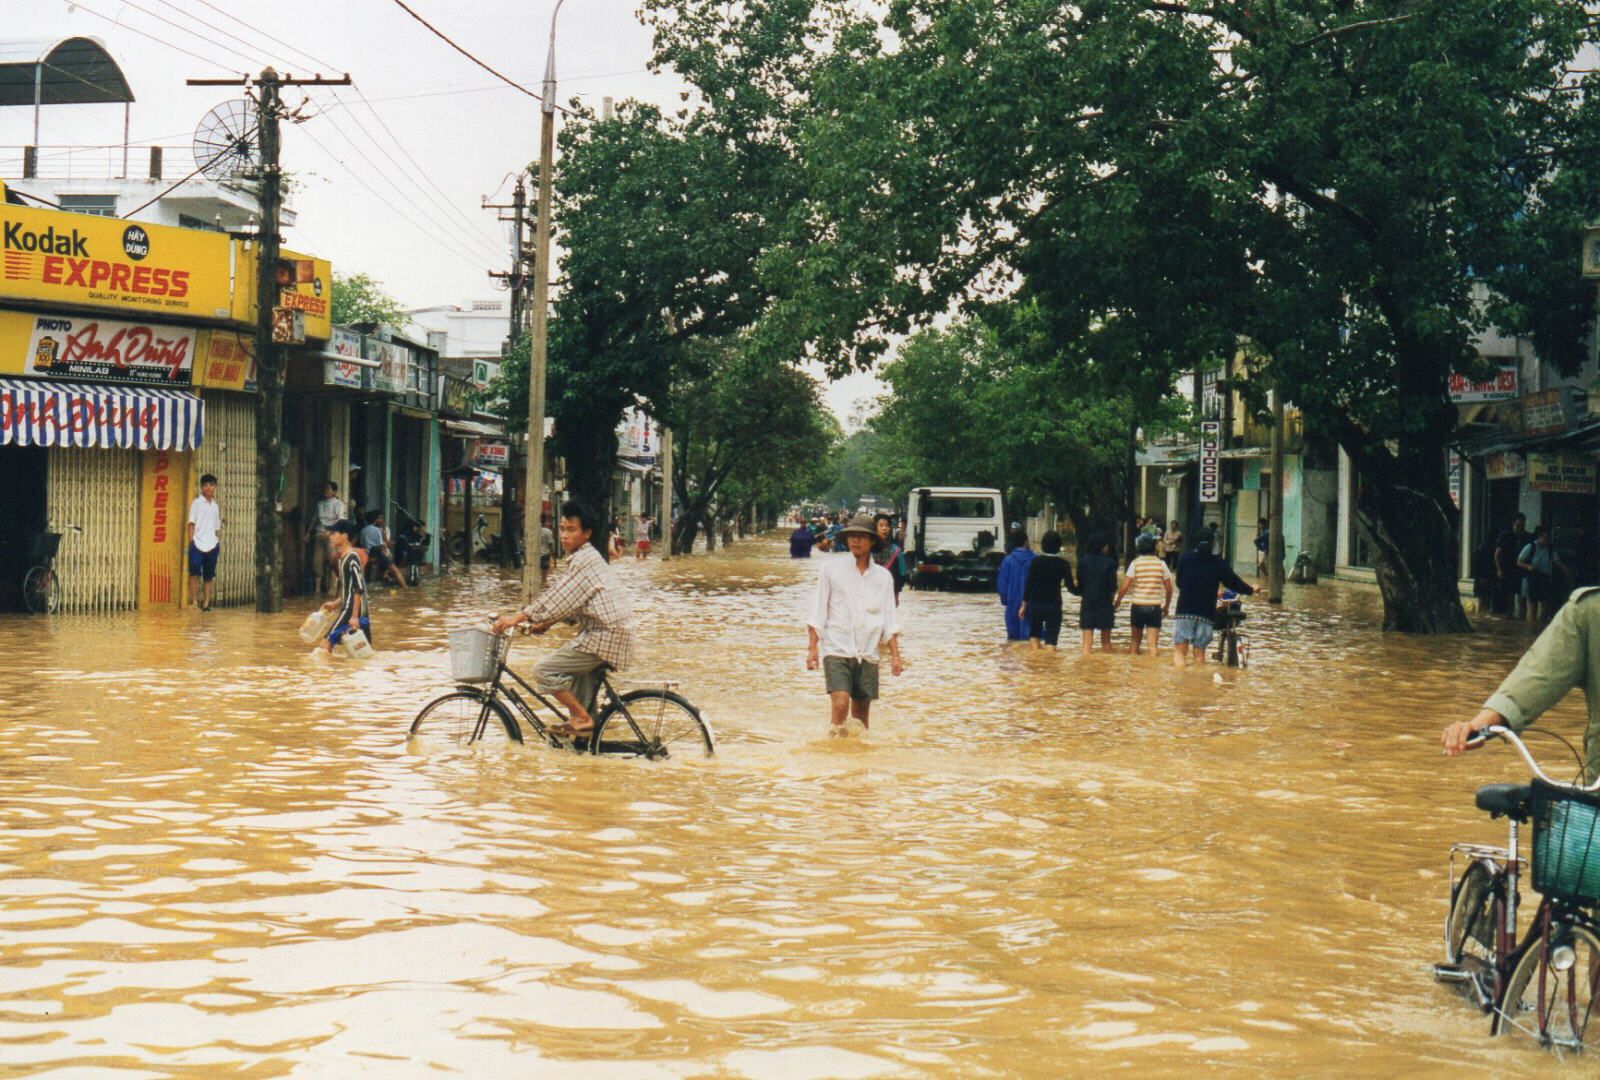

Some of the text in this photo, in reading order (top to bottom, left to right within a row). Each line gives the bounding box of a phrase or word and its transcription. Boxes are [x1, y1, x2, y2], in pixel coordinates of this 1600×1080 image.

[4, 221, 90, 257] Kodak
[43, 255, 190, 298] EXPRESS
[88, 291, 189, 308] QUALITY MONITORING SERVICE
[284, 293, 327, 314] EXPRESS
[36, 318, 72, 332] PHOTO
[60, 322, 128, 369] Anh
[69, 365, 110, 376] MINILAB
[1202, 423, 1218, 499] POTOCOPY
